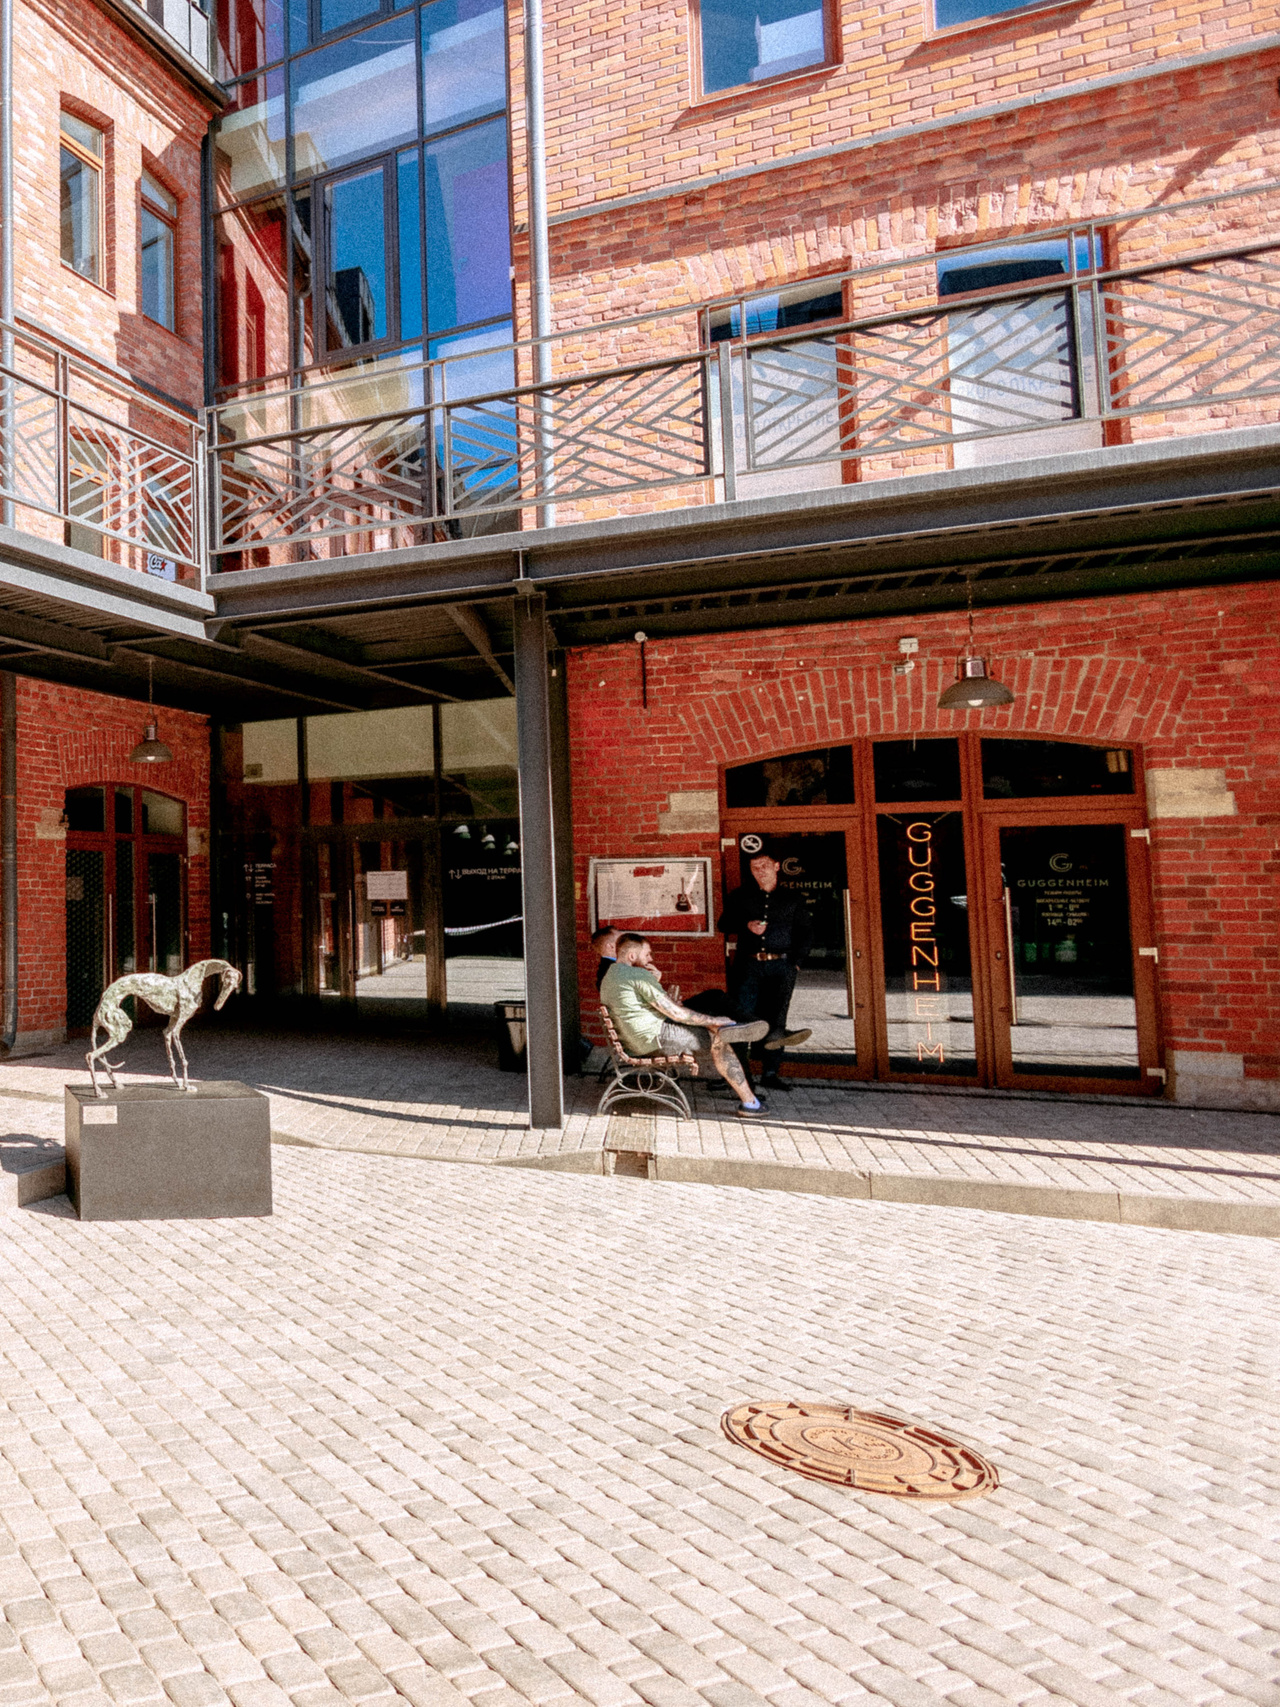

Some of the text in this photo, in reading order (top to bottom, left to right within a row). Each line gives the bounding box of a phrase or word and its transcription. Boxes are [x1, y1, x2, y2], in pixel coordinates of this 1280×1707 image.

[462, 868, 487, 876] ВЫХОД
[1017, 879, 1109, 888] GUGGENHEIM
[907, 822, 945, 1063] GUGGENHEIM
